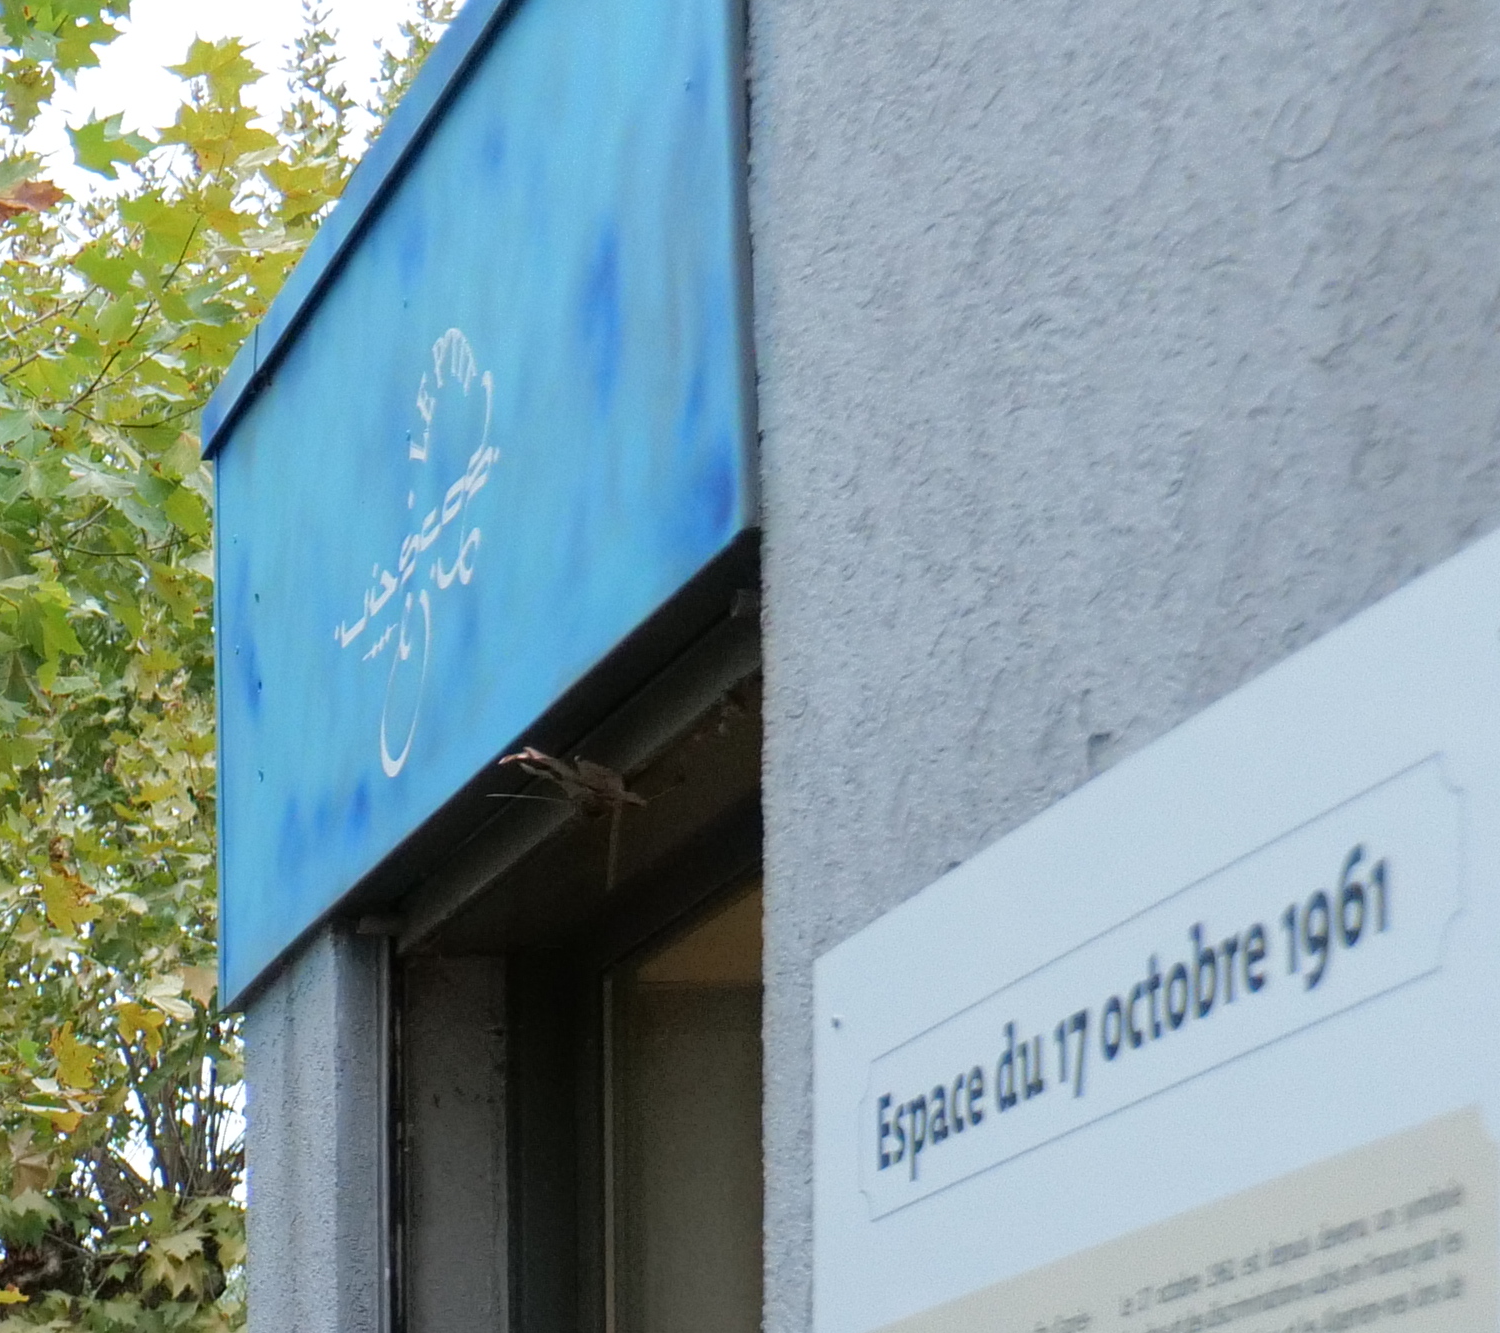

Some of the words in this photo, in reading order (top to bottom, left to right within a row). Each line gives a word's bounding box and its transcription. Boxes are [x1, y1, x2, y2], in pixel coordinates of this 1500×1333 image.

[877, 1064, 985, 1182] Espace
[996, 1020, 1046, 1115] du
[1054, 1007, 1089, 1099] 17
[1100, 920, 1267, 1063] octobre
[1282, 842, 1390, 993] 1961
